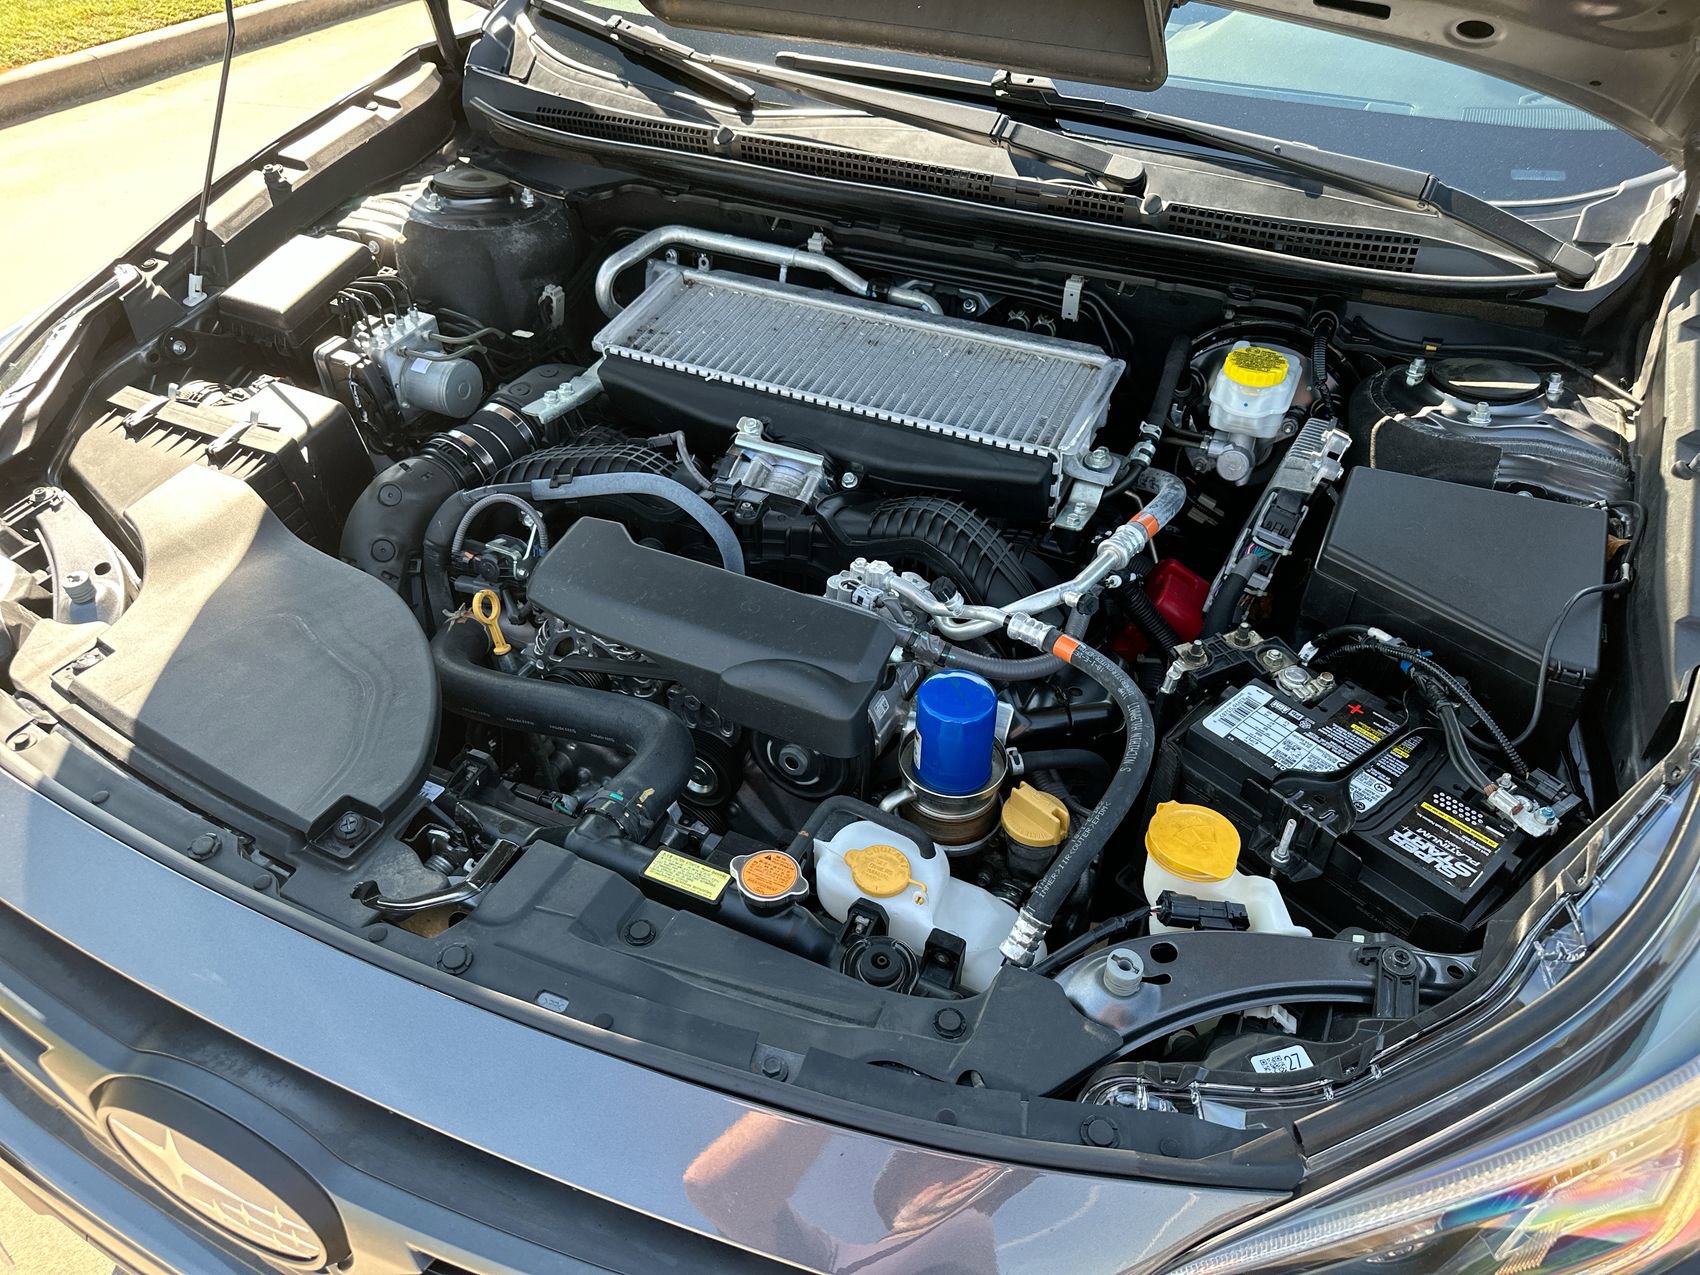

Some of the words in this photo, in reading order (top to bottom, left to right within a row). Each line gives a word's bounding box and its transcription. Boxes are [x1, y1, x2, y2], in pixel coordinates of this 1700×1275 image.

[865, 846, 908, 868] COOLANT
[1387, 832, 1458, 879] SUPER
[1391, 829, 1477, 878] START
[1415, 827, 1481, 867] PLATINUM
[1284, 1053, 1302, 1071] 27
